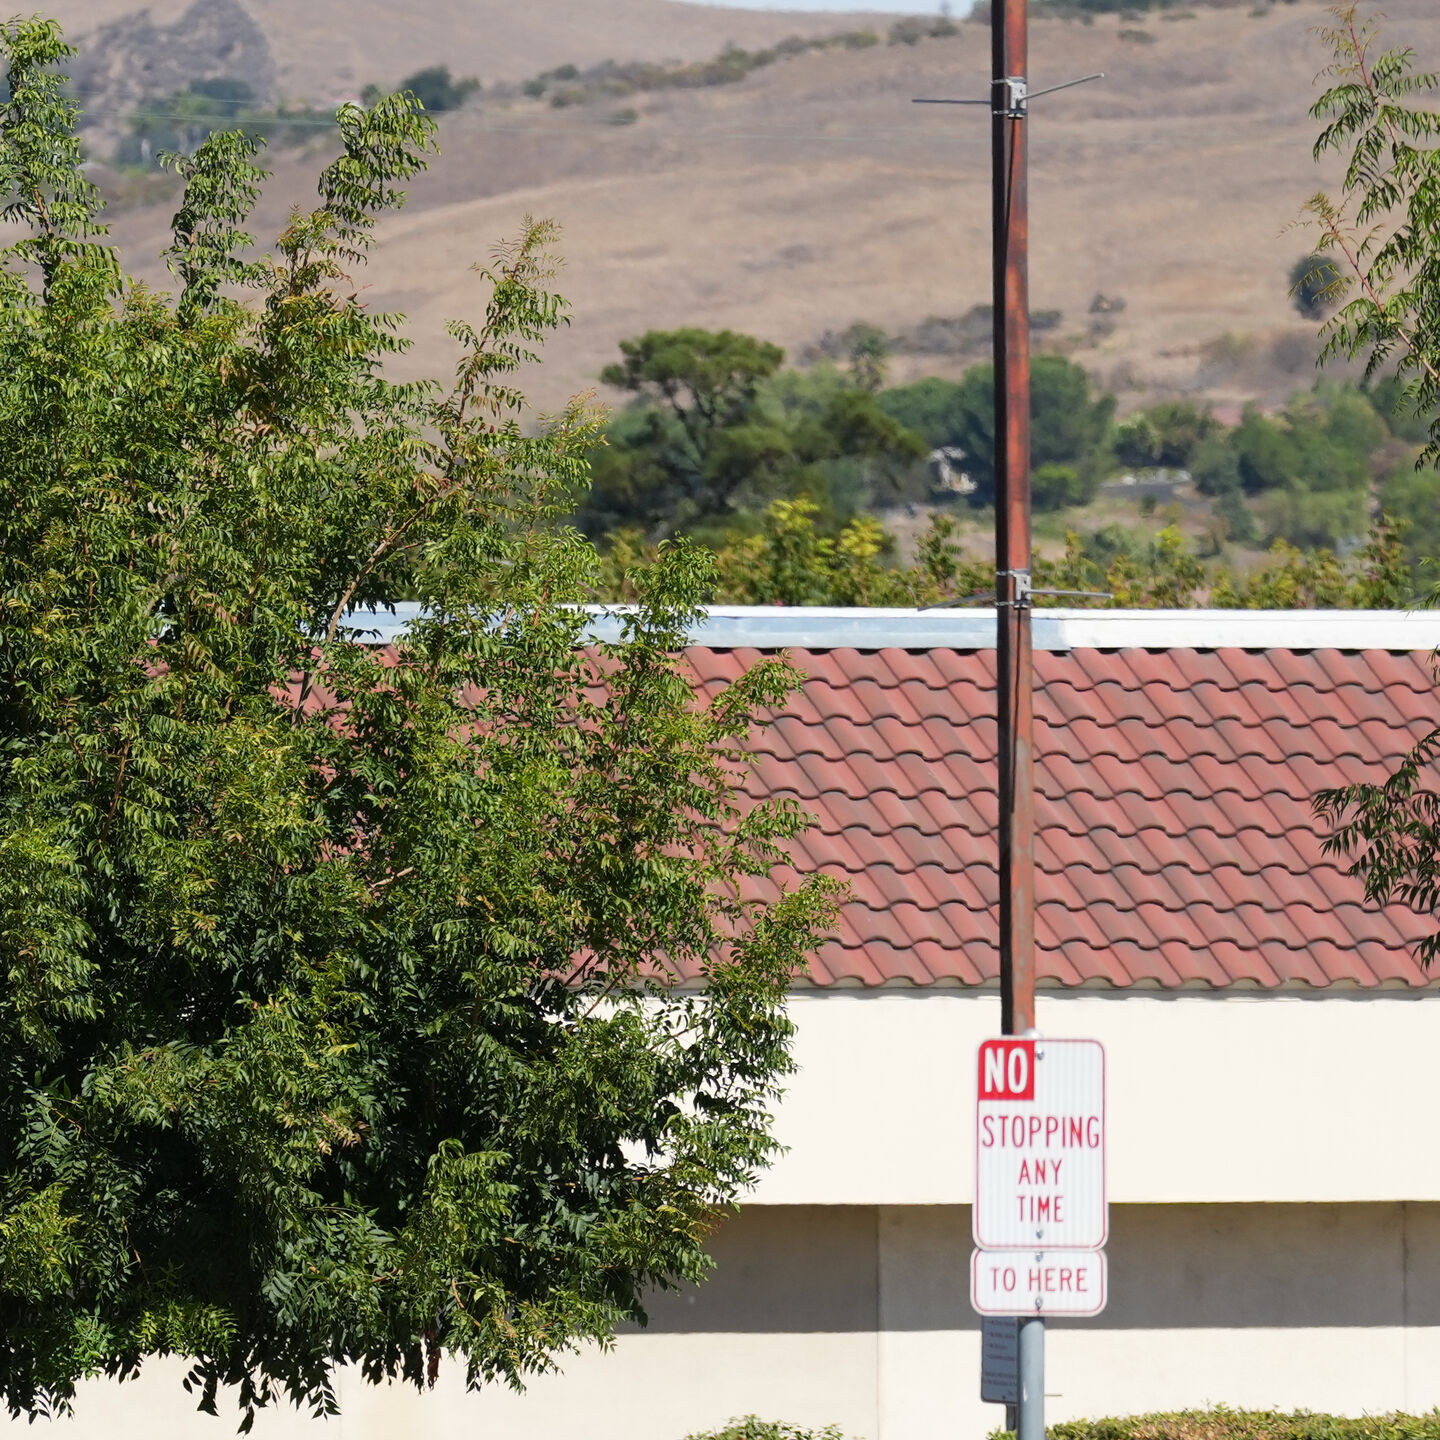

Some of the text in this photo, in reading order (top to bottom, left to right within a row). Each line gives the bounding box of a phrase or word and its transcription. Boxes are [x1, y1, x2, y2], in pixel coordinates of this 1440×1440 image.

[984, 1047, 1029, 1094] NO
[982, 1116, 1100, 1149] STOPPING
[1018, 1159, 1063, 1186] ANY
[1017, 1195, 1065, 1223] TIME
[990, 1267, 1089, 1293] TO HERE
